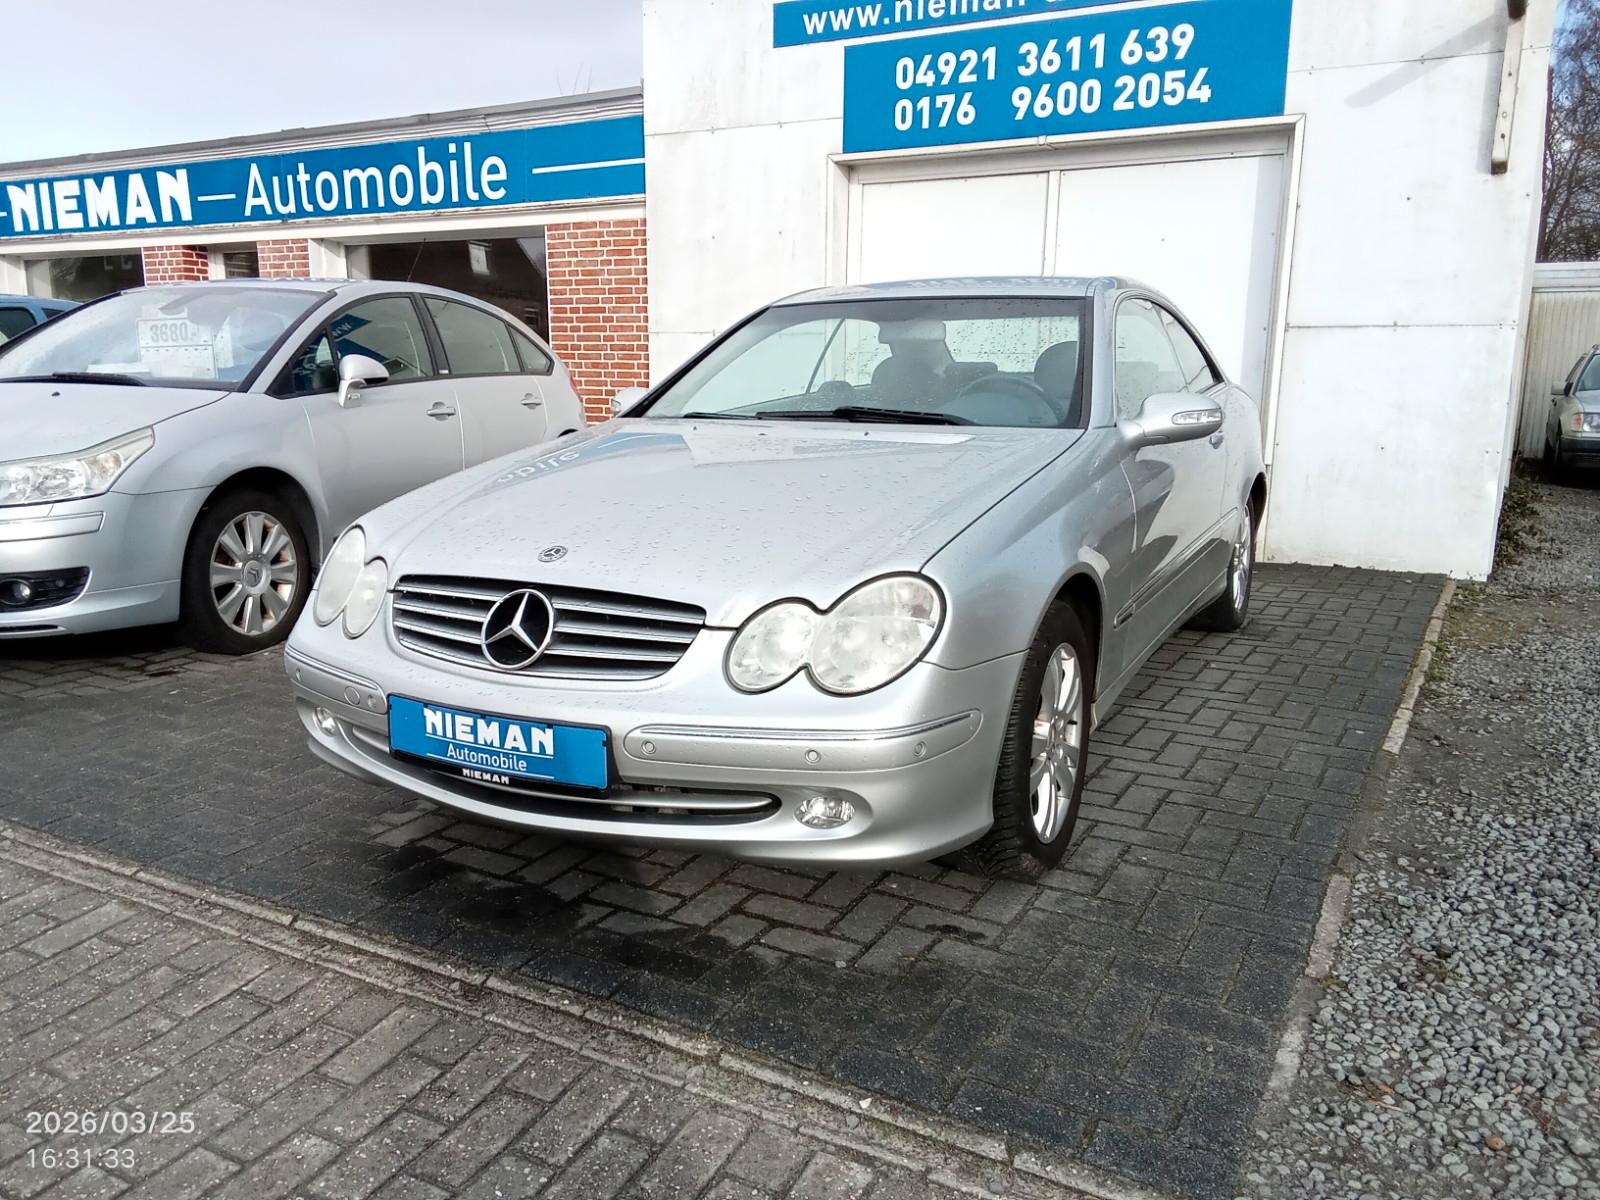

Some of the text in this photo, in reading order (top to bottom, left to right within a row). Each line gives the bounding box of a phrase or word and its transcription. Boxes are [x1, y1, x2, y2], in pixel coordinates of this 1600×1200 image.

[894, 23, 1195, 90] 04921 3611 639
[894, 67, 1212, 131] 0176 9600 2054
[6, 142, 509, 233] NIEMAN Automobile
[423, 707, 555, 756] NIEMAN
[446, 743, 528, 772] Automobile
[462, 768, 510, 785] NIEMAN
